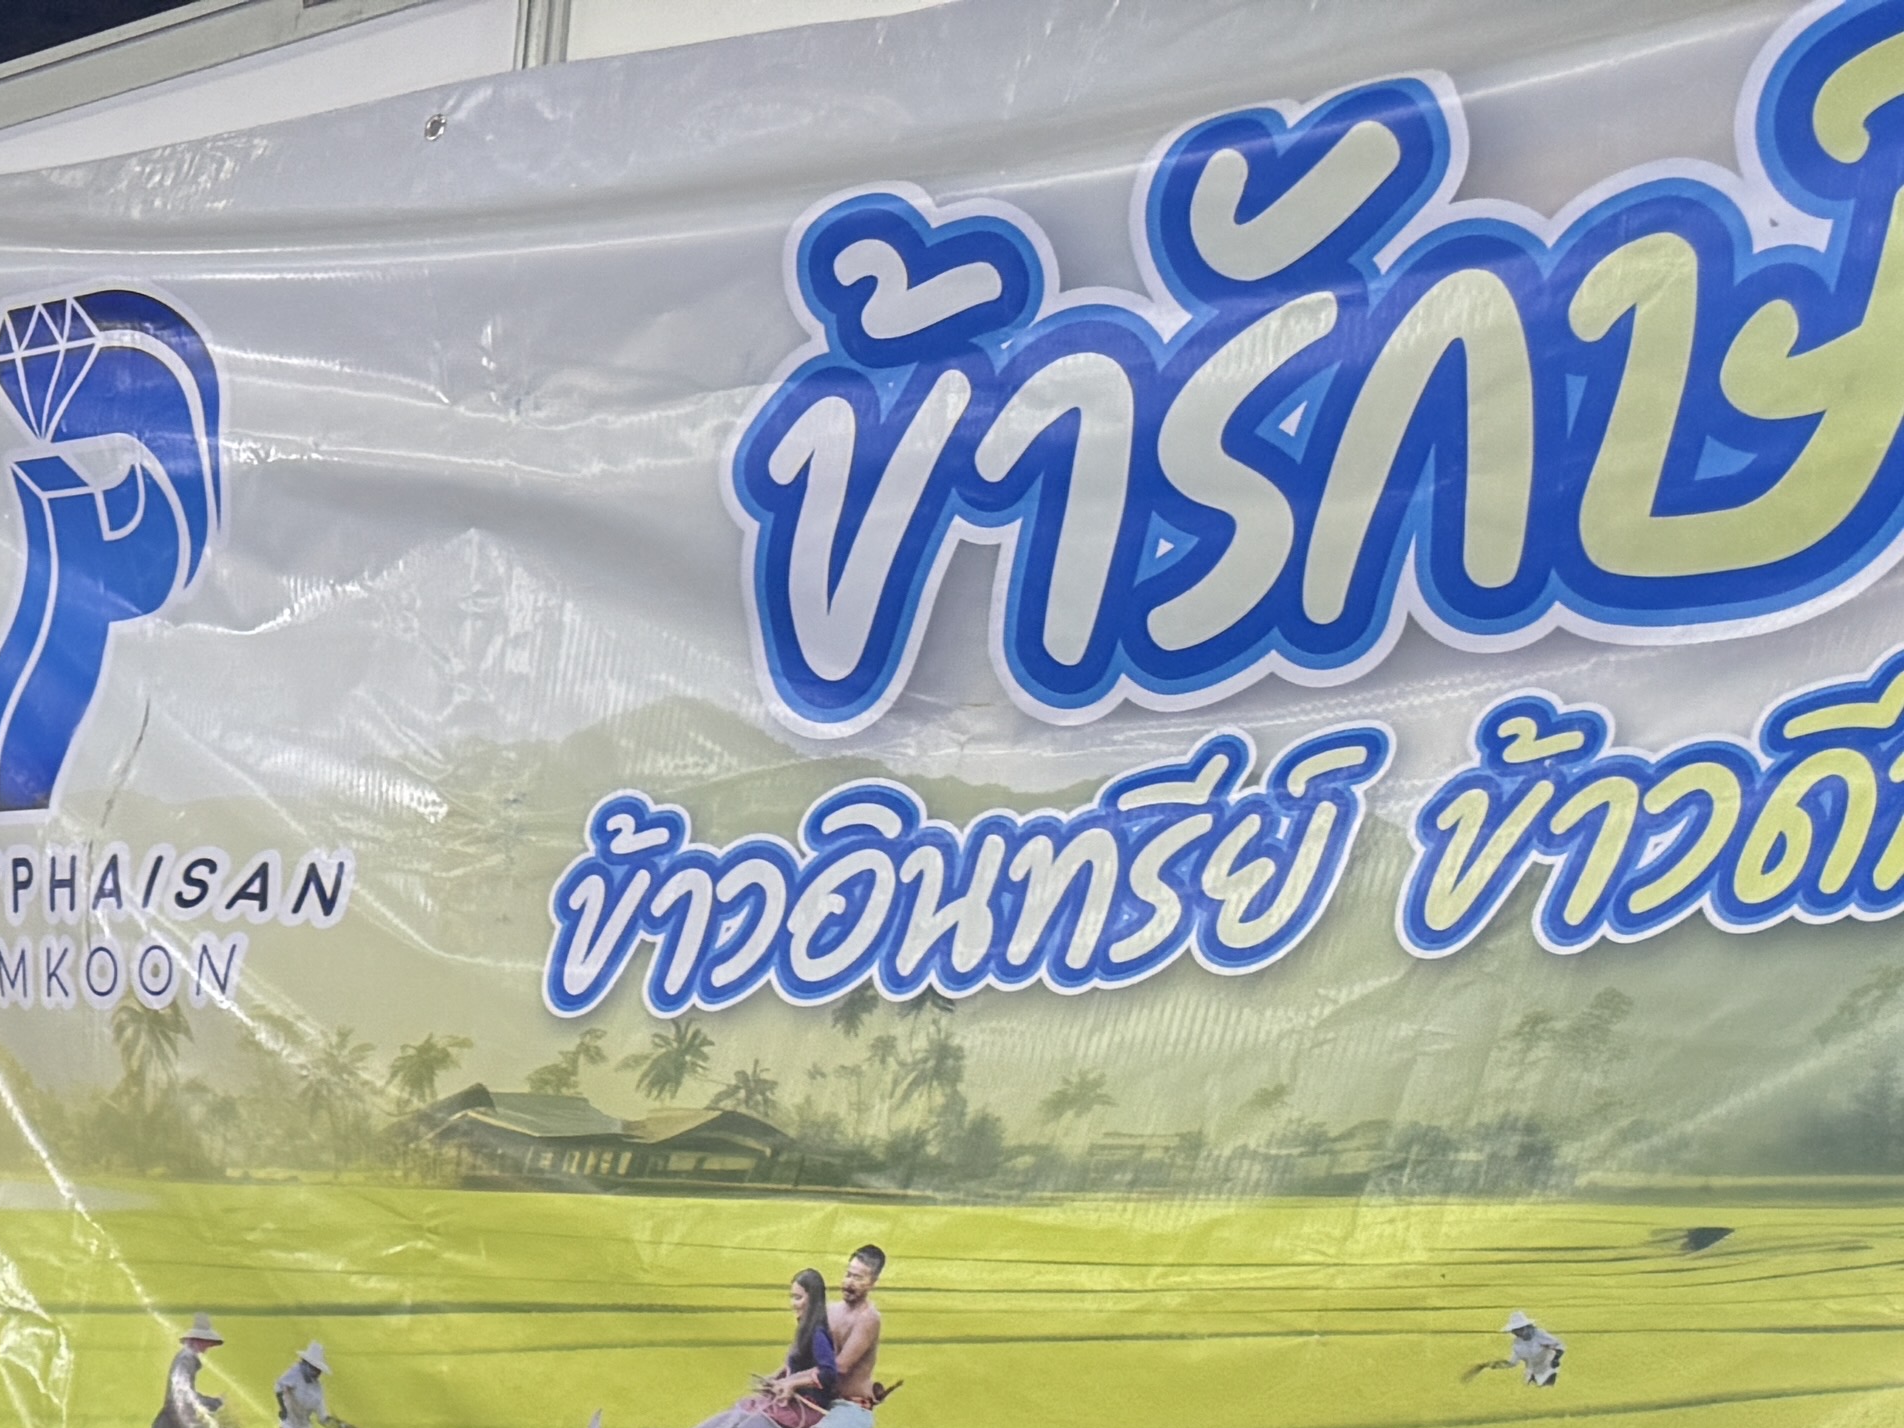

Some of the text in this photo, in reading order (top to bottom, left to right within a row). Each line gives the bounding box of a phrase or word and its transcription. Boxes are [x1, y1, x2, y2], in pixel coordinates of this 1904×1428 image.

[550, 725, 1394, 1015] ข้าวอินทรีย์
